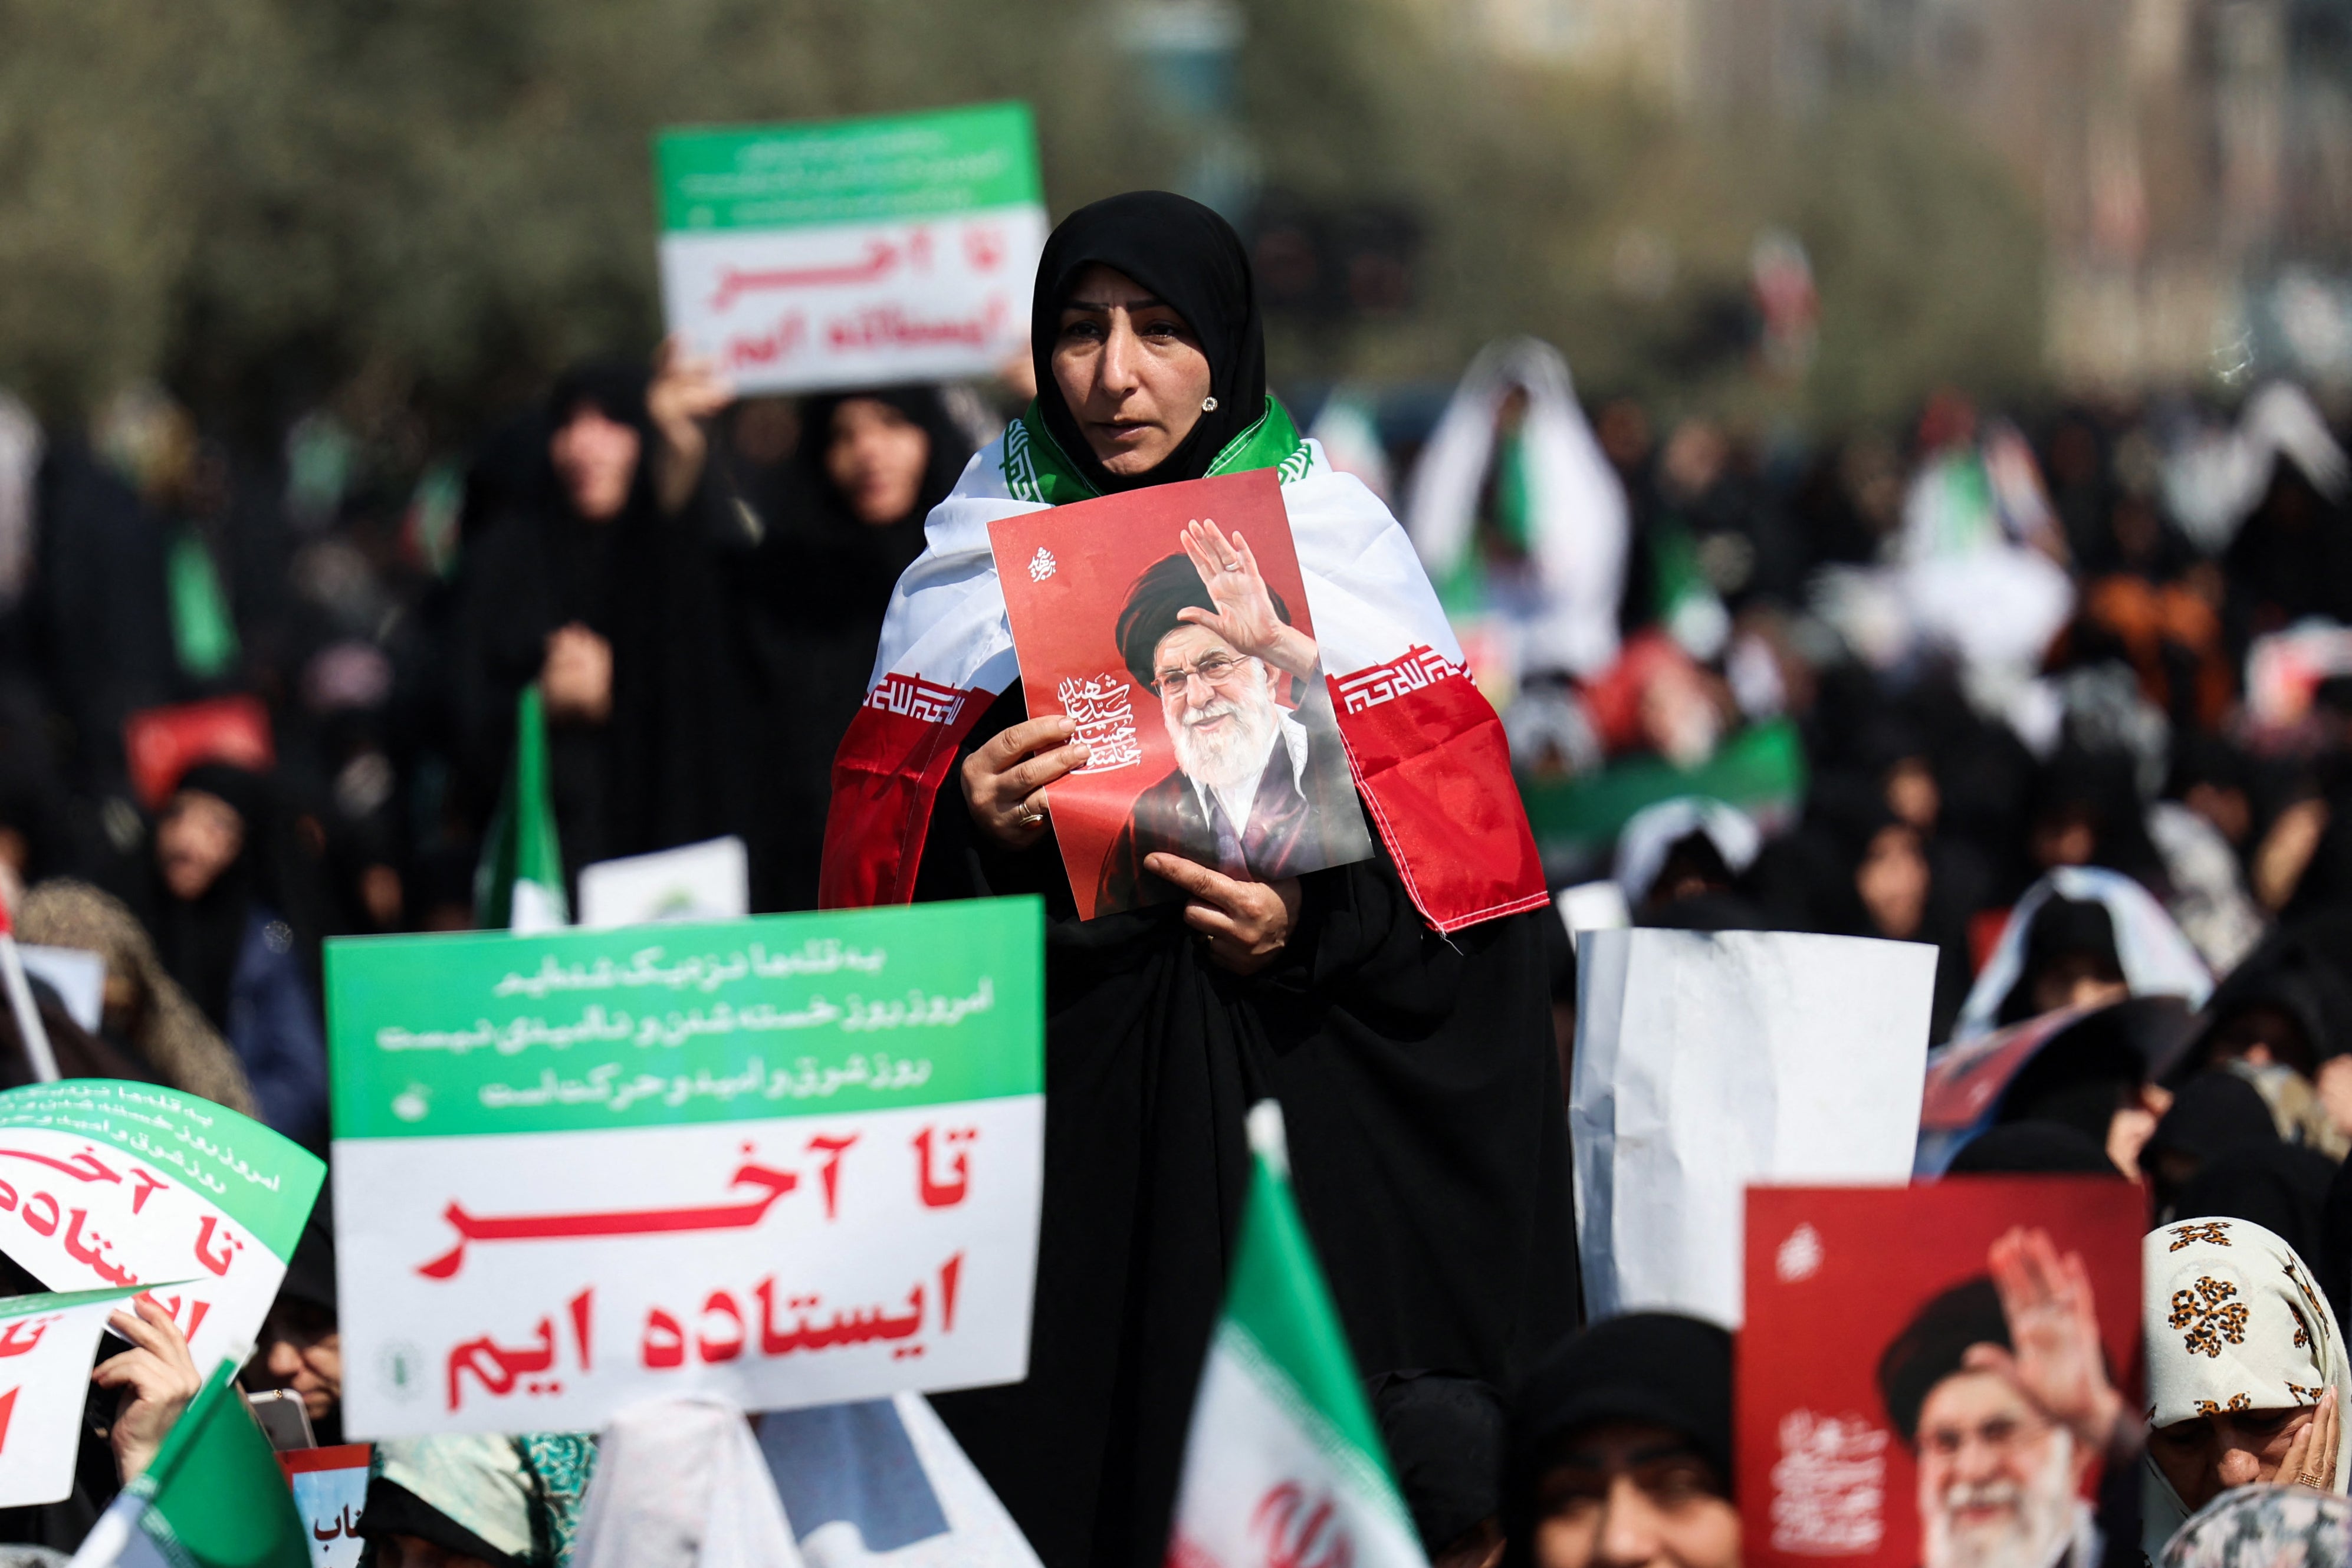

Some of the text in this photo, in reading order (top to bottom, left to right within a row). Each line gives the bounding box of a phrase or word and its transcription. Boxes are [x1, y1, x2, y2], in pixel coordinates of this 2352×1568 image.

[130, 1132, 185, 1168] شوق
[175, 1125, 219, 1156] روز
[183, 1161, 226, 1194] روز
[218, 1147, 280, 1192] امروز
[0, 1146, 244, 1276] تا آخ
[411, 1125, 981, 1284] تا آخر
[442, 1284, 597, 1416] ایم
[640, 1251, 966, 1370] ایستاده
